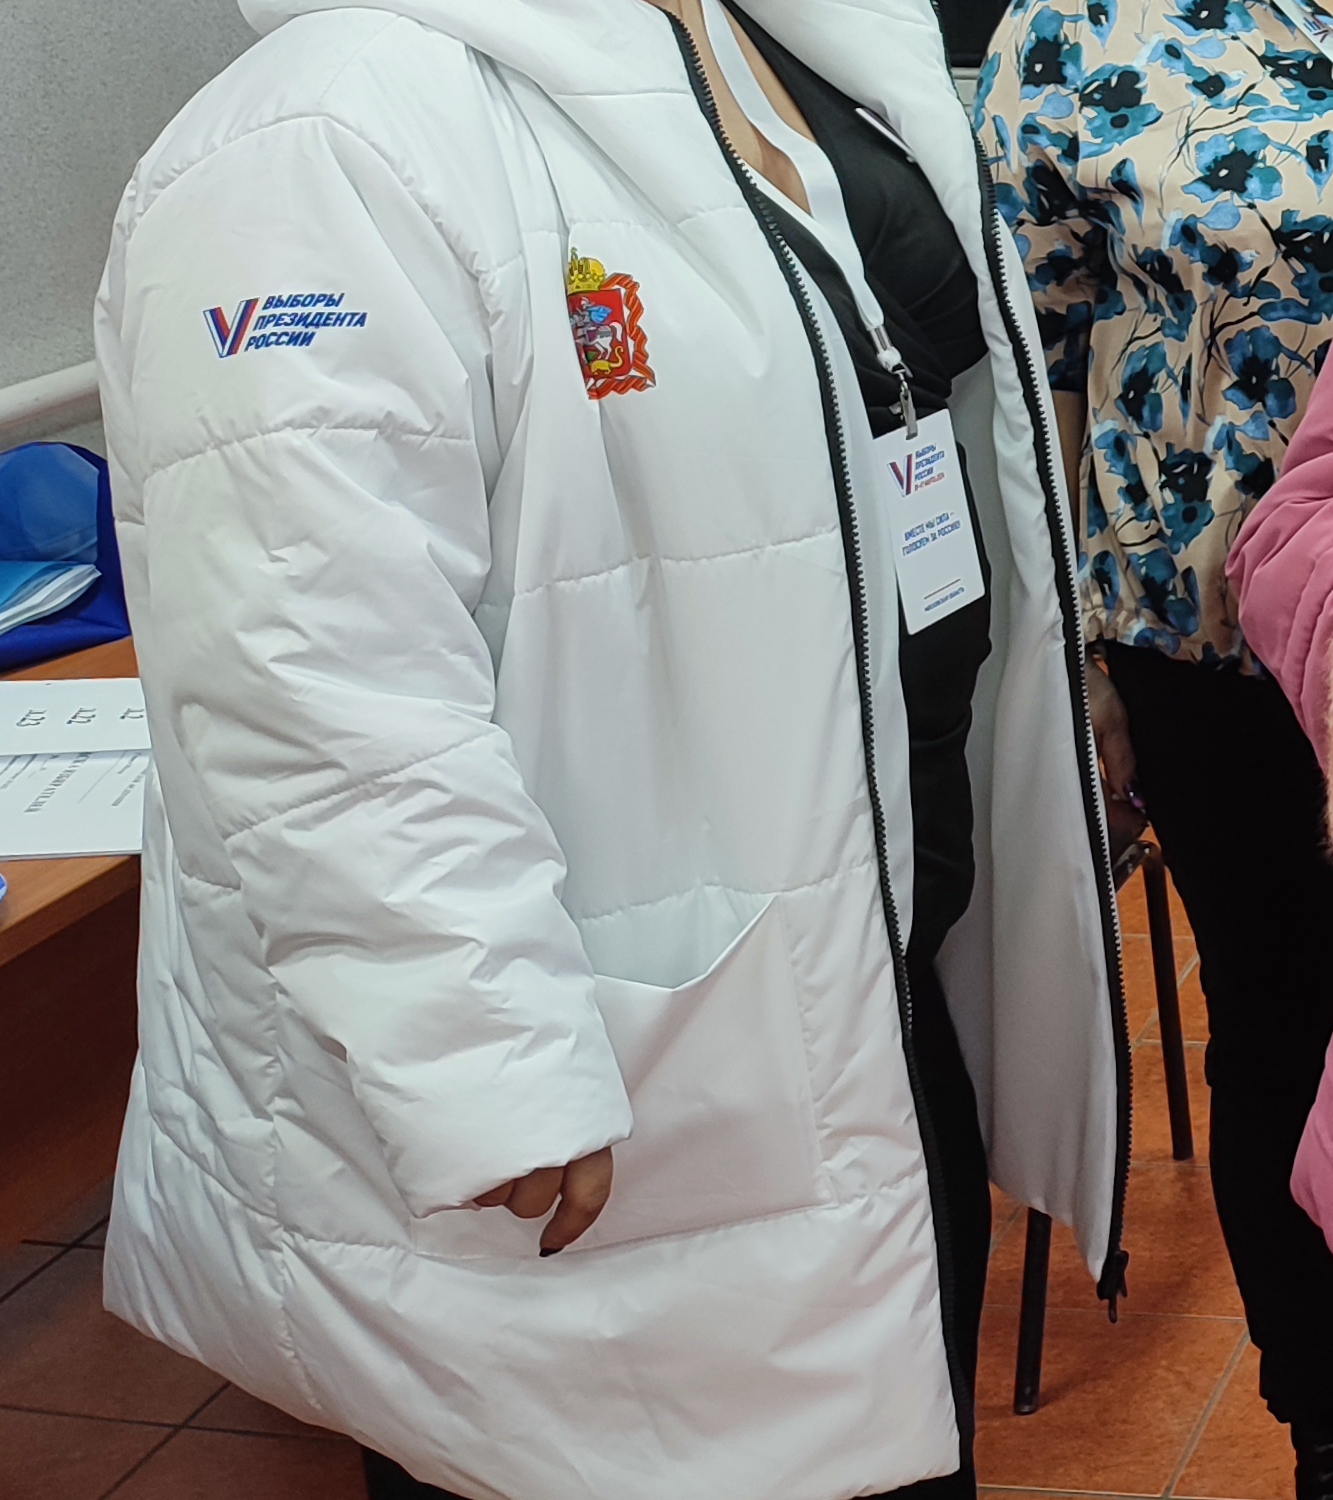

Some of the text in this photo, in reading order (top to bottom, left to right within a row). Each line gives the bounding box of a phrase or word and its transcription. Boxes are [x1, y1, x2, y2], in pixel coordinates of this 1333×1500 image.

[262, 293, 345, 310] ВЫБОРЫ
[253, 311, 367, 331] ПРЕЗИДЕНТА
[244, 331, 316, 352] РОССИИ
